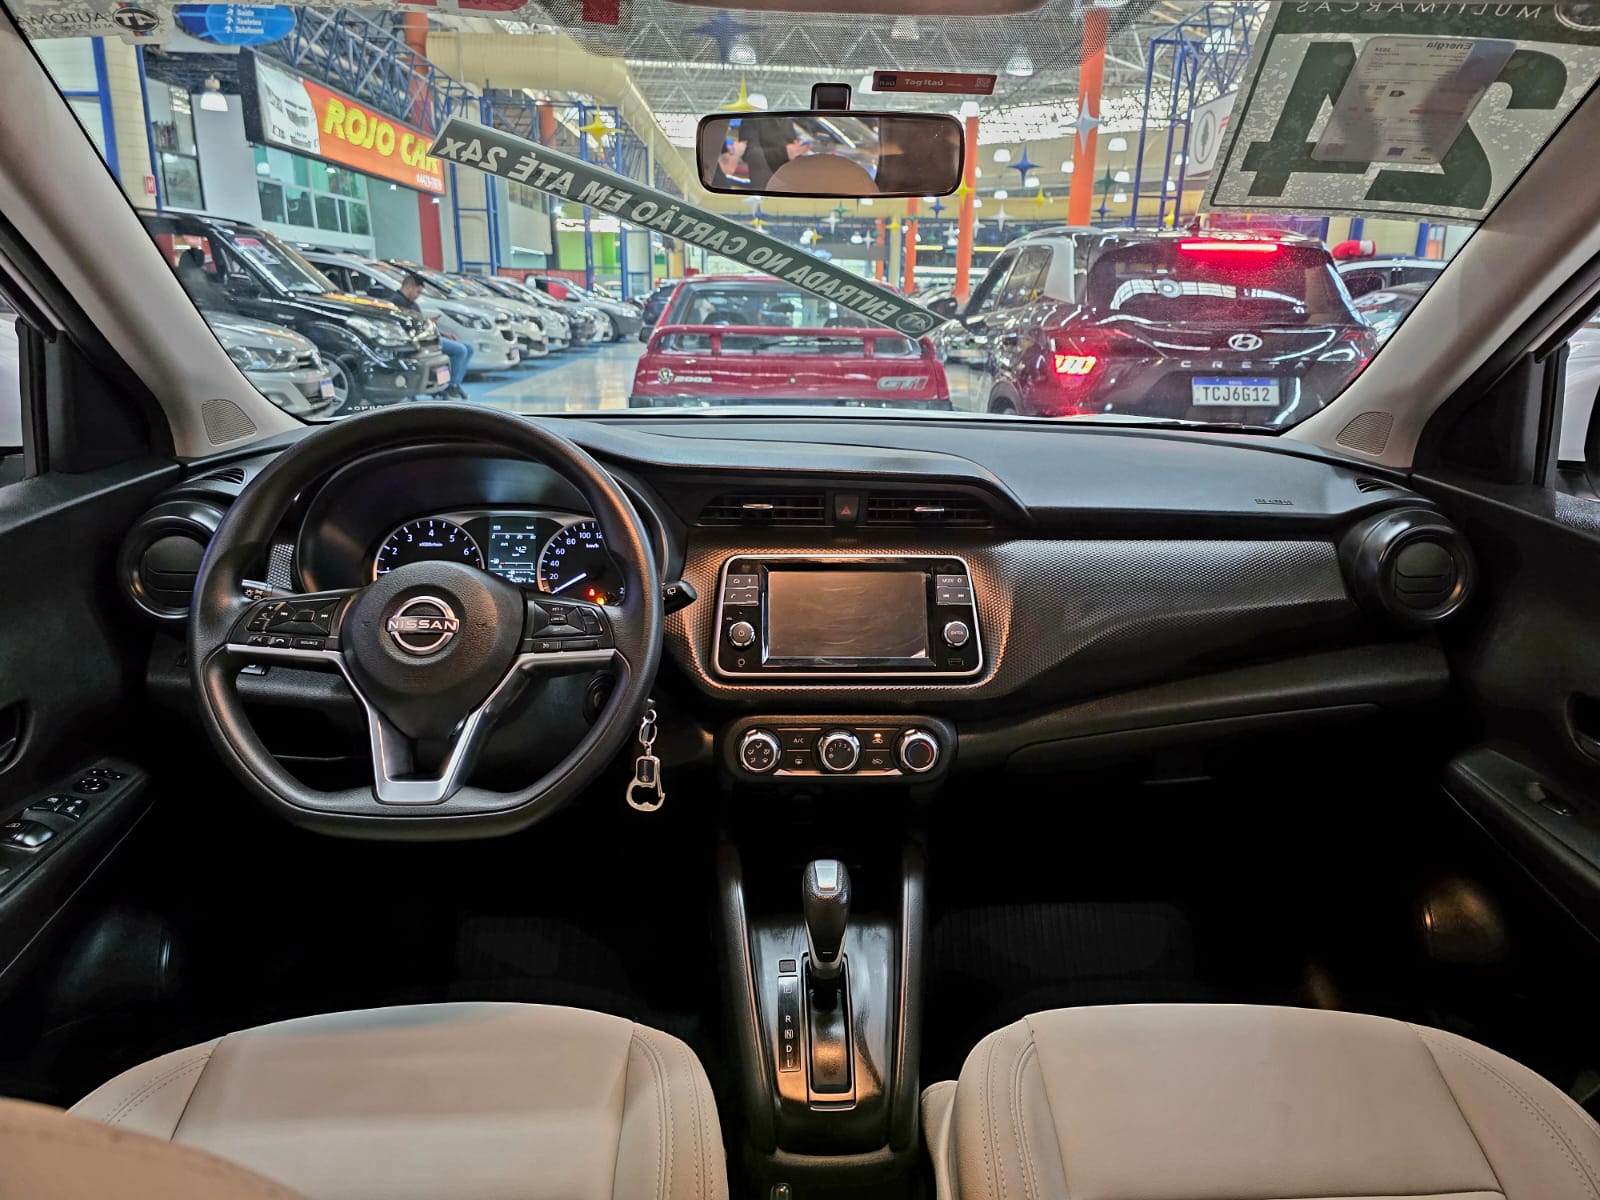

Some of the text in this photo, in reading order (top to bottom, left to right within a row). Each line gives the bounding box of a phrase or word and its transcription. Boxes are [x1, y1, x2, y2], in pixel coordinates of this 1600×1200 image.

[904, 78, 921, 87] Tag
[323, 98, 395, 157] ROJO
[1180, 360, 1306, 369] CRETA
[1202, 386, 1271, 402] TCJ6G12
[428, 528, 435, 537] 4
[407, 533, 413, 543] 3
[449, 534, 455, 543] 5
[391, 547, 398, 556] 2
[463, 547, 470, 556] 6
[549, 572, 559, 580] 20
[388, 618, 458, 631] NISSAN
[785, 1015, 792, 1023] R
[786, 1045, 793, 1053] D
